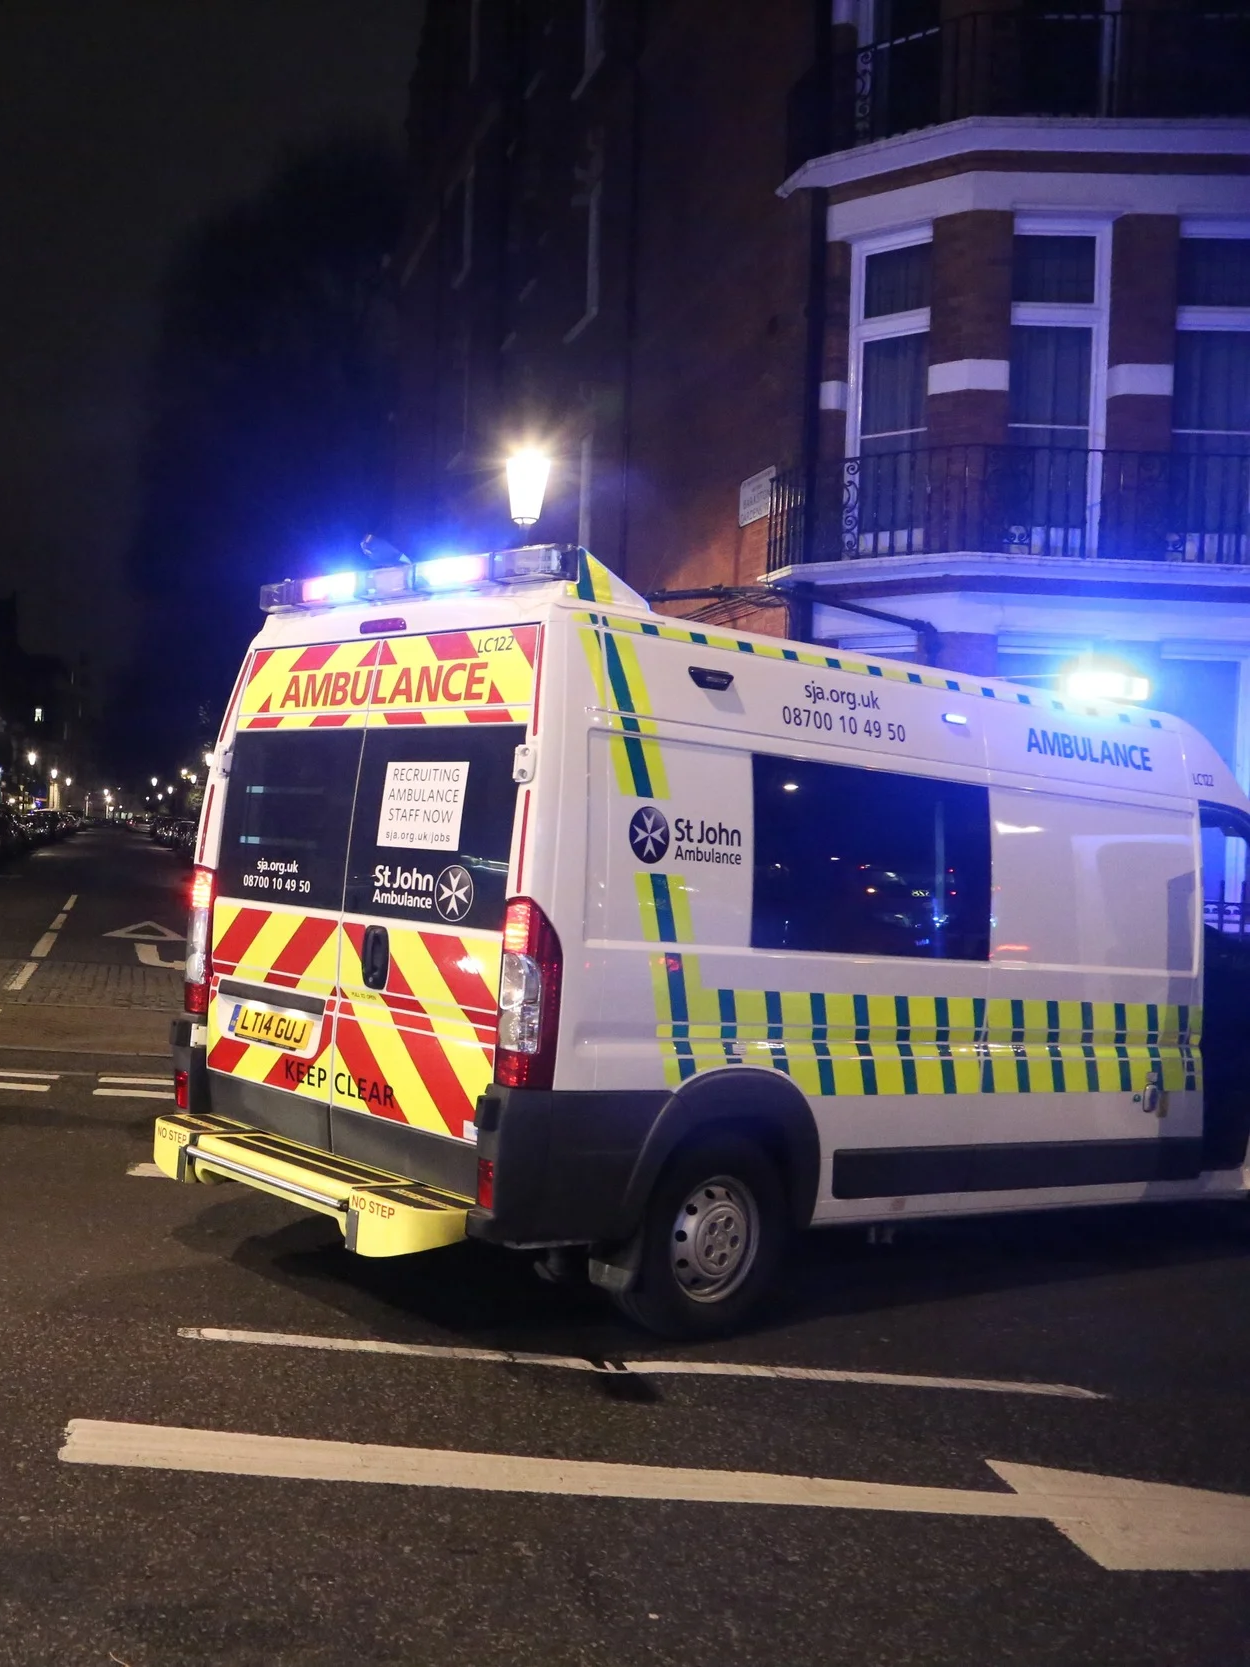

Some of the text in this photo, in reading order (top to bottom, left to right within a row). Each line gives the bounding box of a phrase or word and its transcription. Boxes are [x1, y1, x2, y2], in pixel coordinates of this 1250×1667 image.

[477, 635, 514, 654] LC122
[280, 662, 488, 708] AMBULANCE
[804, 681, 880, 710] sja.org.uk
[782, 706, 906, 742] 08700 10 49 50
[1027, 727, 1153, 772] AMBULANCE
[393, 768, 460, 782] RECRUITING
[387, 788, 459, 803] AMBULANCE
[388, 808, 453, 823] STAFF NOW
[674, 818, 741, 847] St John
[674, 845, 742, 865] Ambulance
[256, 858, 299, 875] sja.org.uk
[243, 874, 311, 893] 08700 10 49 50
[374, 864, 434, 892] St John
[372, 889, 432, 909] Ambulance
[240, 1009, 273, 1036] LT14
[274, 1017, 307, 1043] GUJ
[285, 1058, 394, 1108] KEEP CLEAR
[157, 1126, 187, 1144] NO STEP
[351, 1194, 395, 1219] NO STEP
